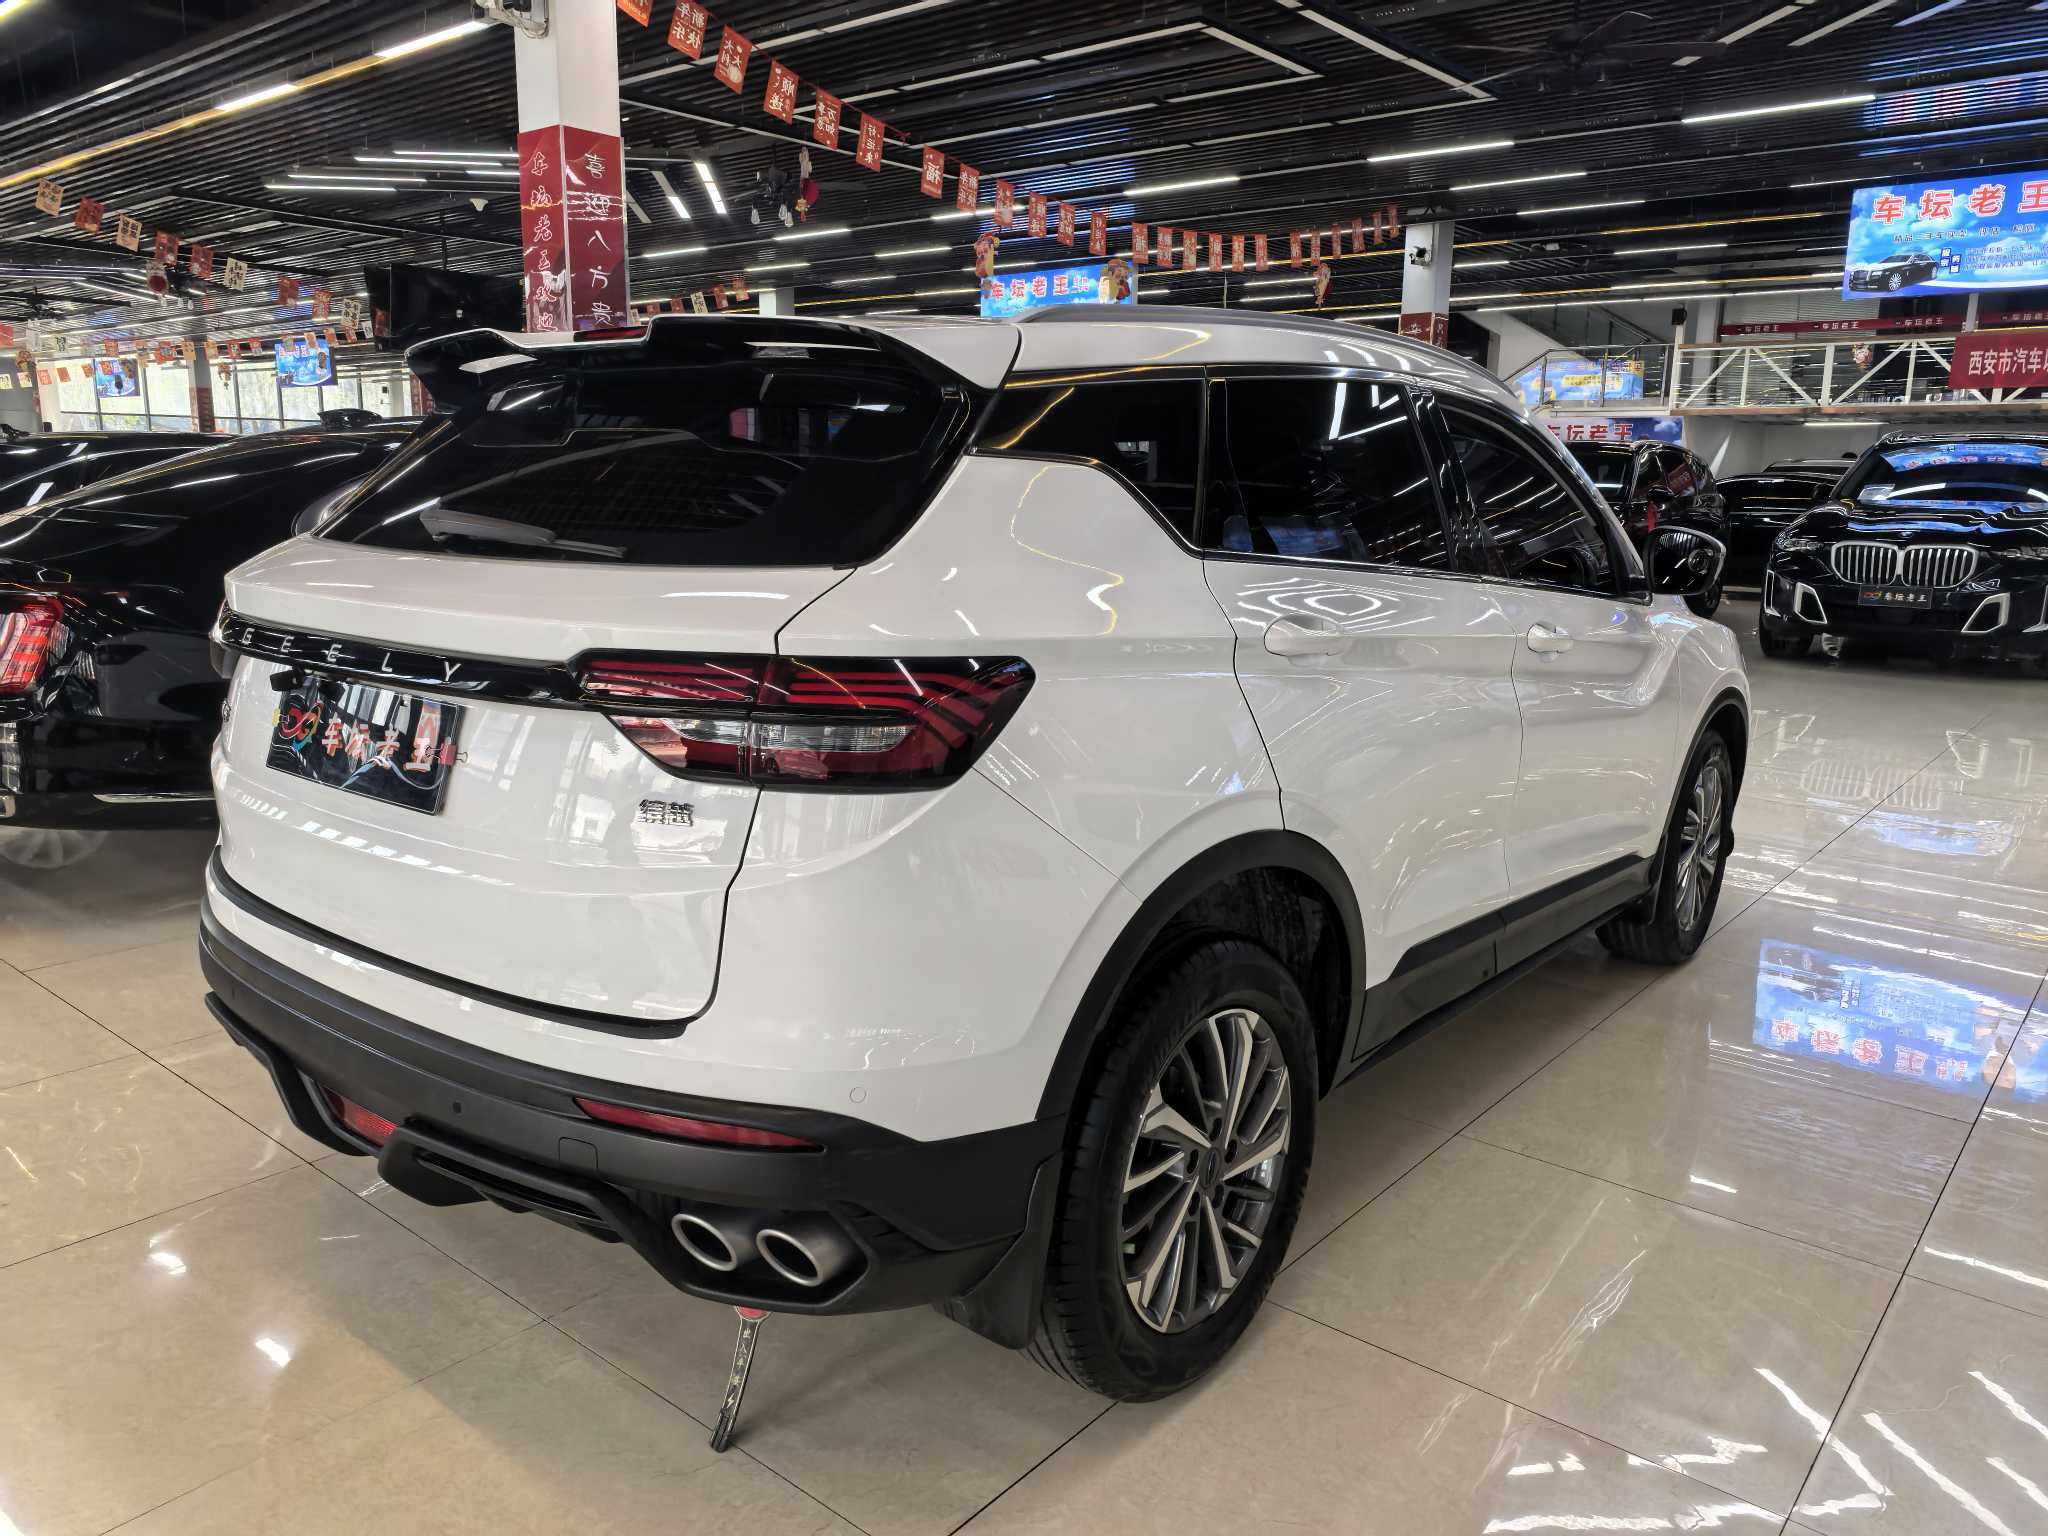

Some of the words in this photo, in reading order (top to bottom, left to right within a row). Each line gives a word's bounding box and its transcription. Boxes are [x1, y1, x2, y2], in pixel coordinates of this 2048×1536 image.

[1872, 180, 2048, 224] 车坛老王
[242, 627, 461, 683] GEELY
